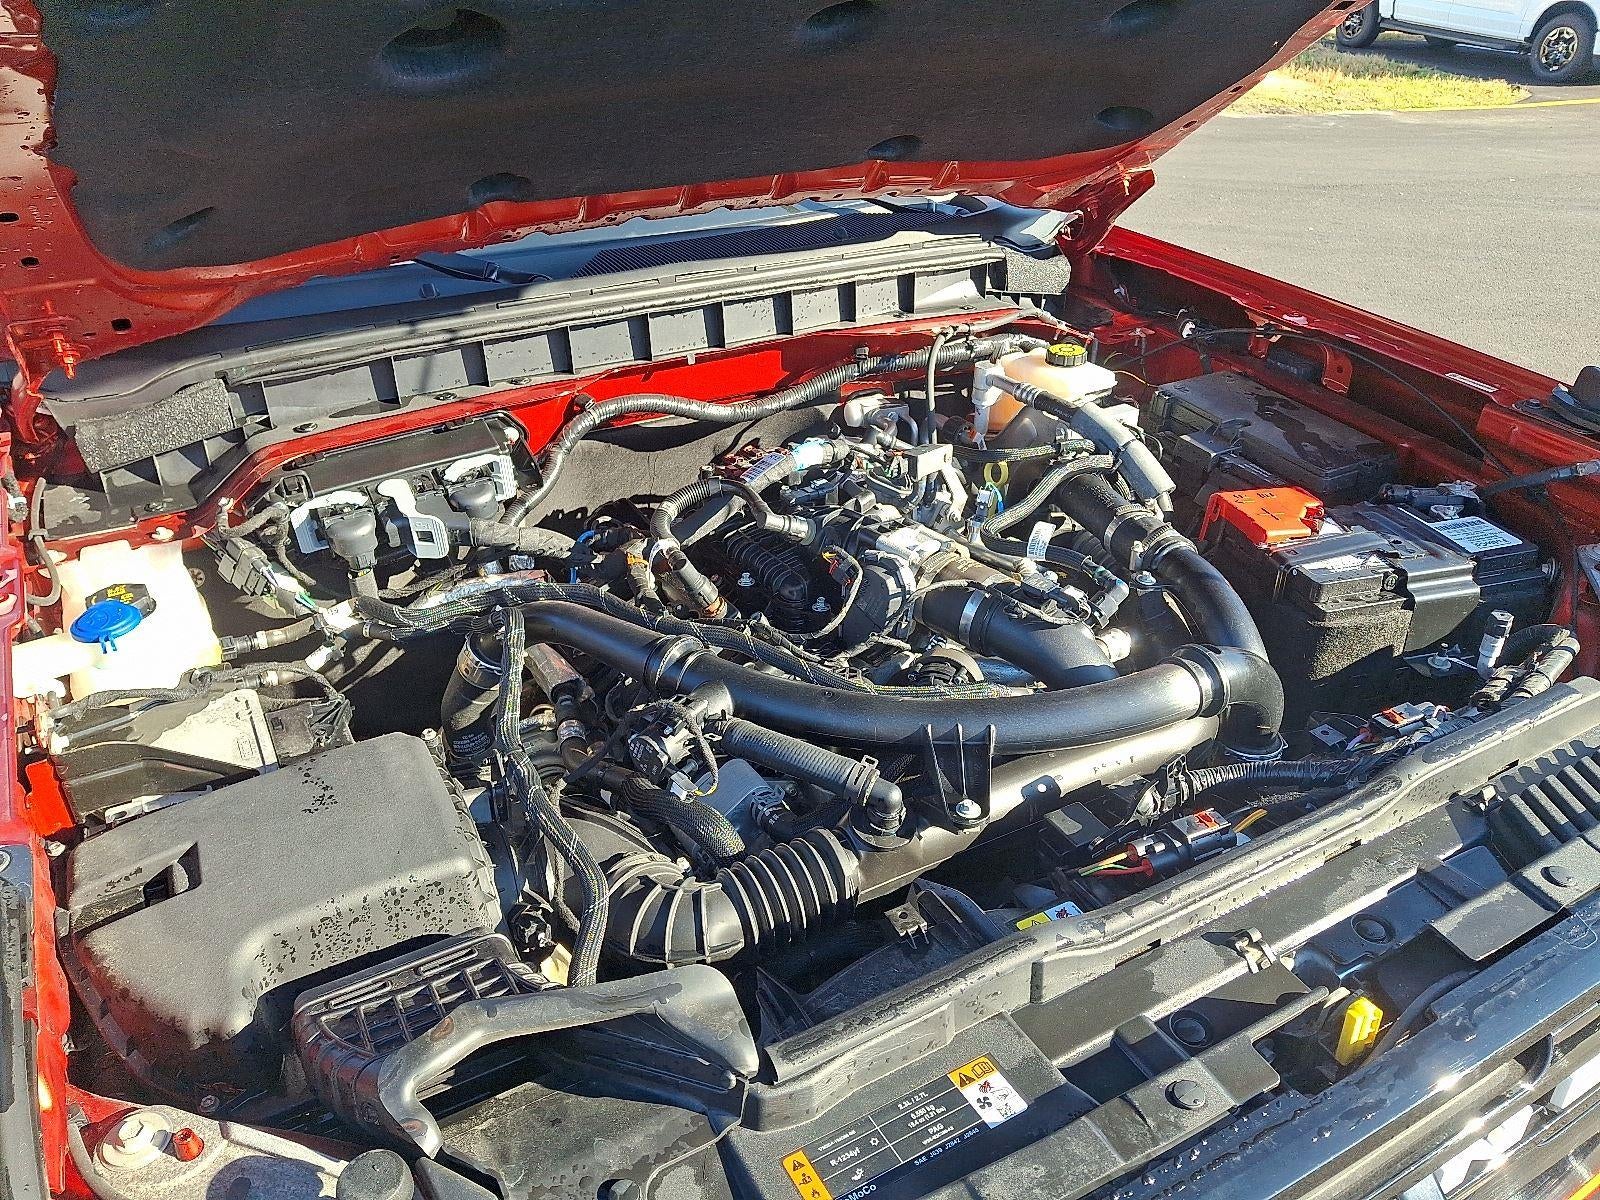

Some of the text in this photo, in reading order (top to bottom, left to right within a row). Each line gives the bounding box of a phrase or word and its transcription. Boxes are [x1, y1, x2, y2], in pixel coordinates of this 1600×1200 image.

[927, 1122, 944, 1135] PAG
[829, 1146, 861, 1167] R-1234yf
[914, 1156, 928, 1167] SAE
[840, 1184, 877, 1200] MoCo
